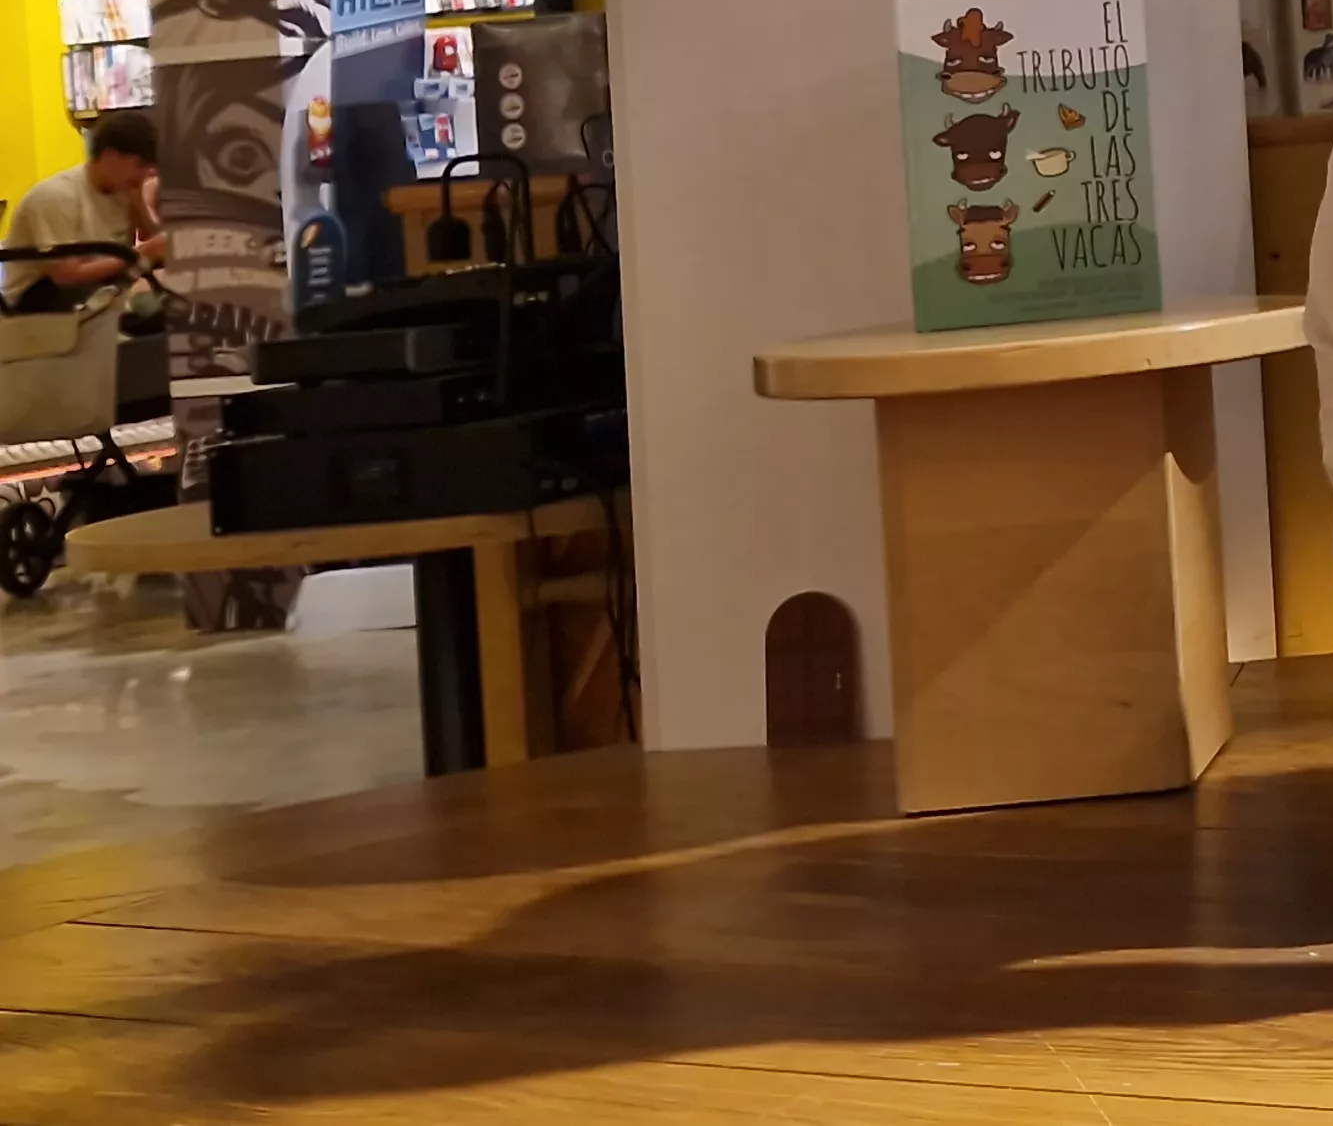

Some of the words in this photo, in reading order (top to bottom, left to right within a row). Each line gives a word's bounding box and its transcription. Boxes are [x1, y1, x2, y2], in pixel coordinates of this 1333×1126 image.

[1102, 0, 1129, 44] EL
[1016, 44, 1131, 94] TRIBUTO
[1102, 88, 1134, 133] DE
[1090, 133, 1137, 179] LAS
[1081, 178, 1139, 224] TRES
[1052, 224, 1142, 271] VACAS
